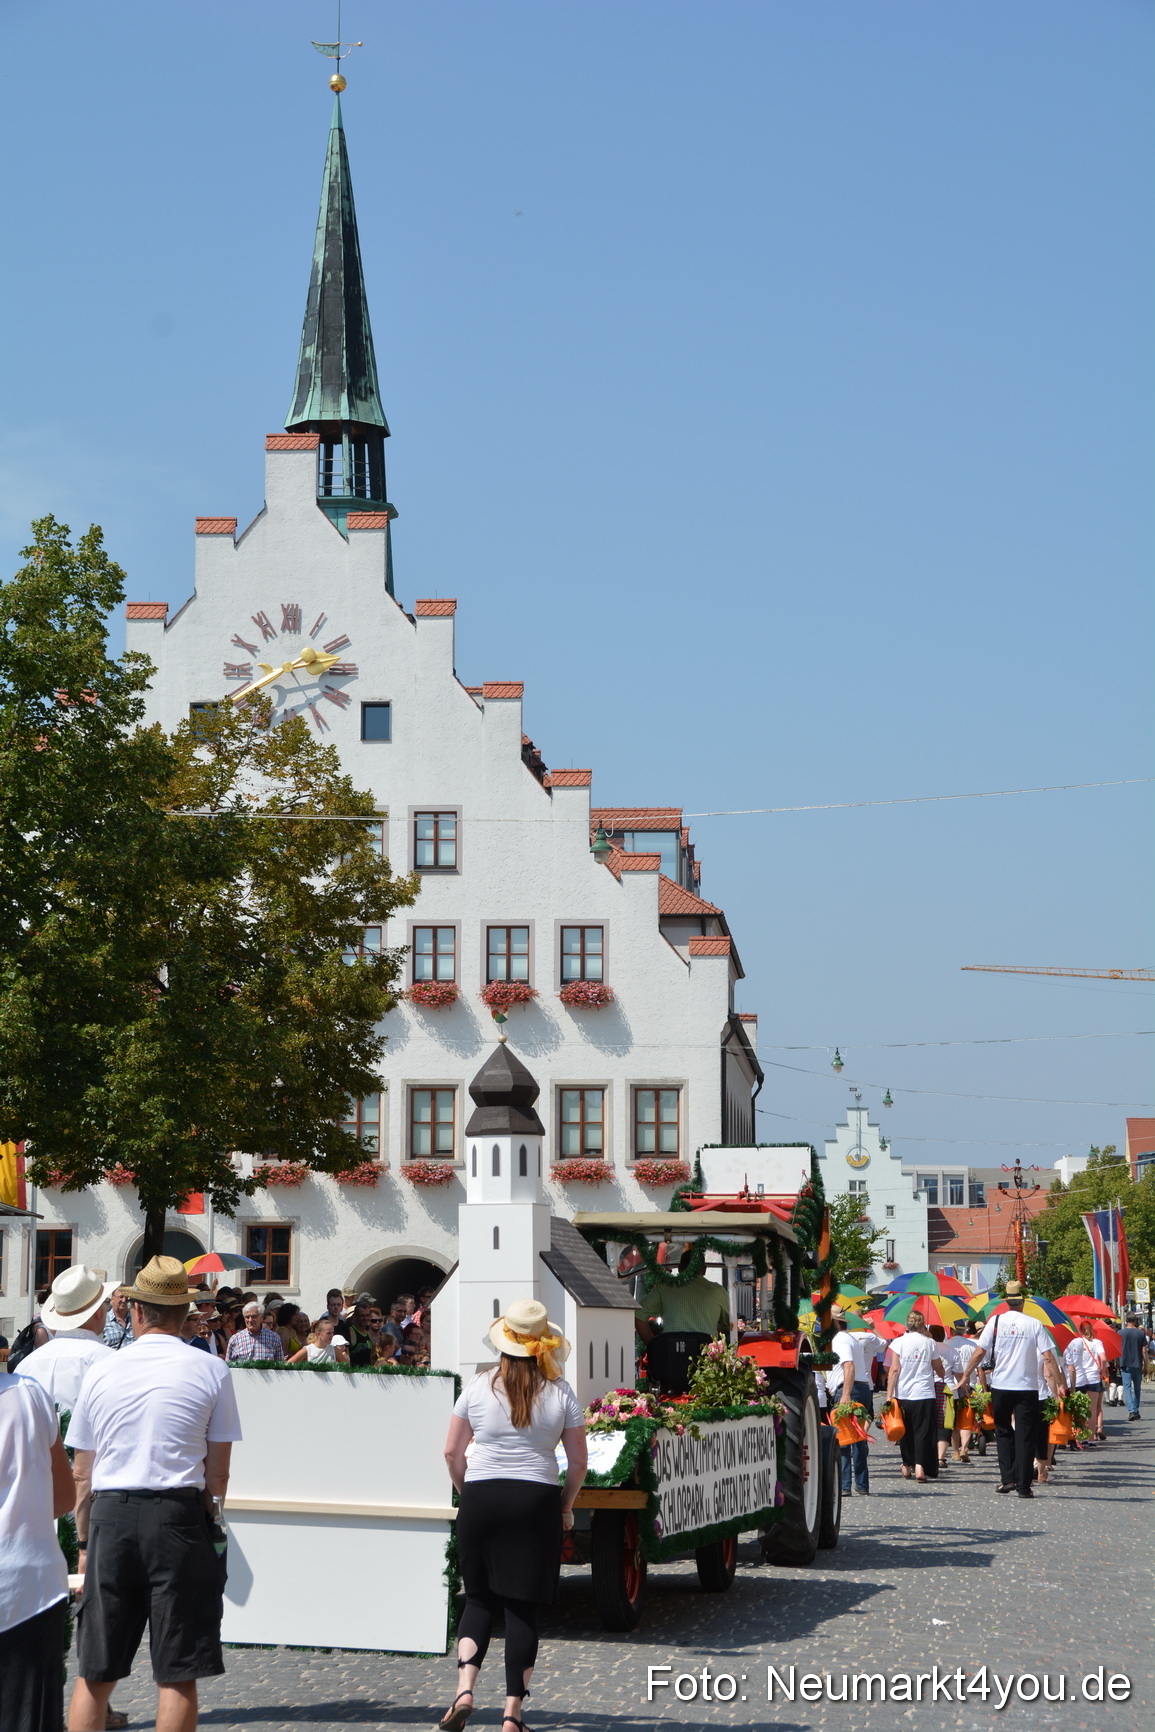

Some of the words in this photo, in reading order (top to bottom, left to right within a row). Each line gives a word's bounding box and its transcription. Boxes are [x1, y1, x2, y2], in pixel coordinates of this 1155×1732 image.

[280, 603, 299, 631] XII
[230, 633, 259, 659] X
[223, 661, 252, 676] IX
[656, 1440, 671, 1483] DAS
[673, 1432, 720, 1479] WOHNZIMMER
[722, 1429, 736, 1471] VON
[737, 1426, 776, 1465] WOFFENBACH
[713, 1475, 739, 1521] GARTEN
[739, 1473, 752, 1514] DER
[753, 1467, 772, 1509] SINNE
